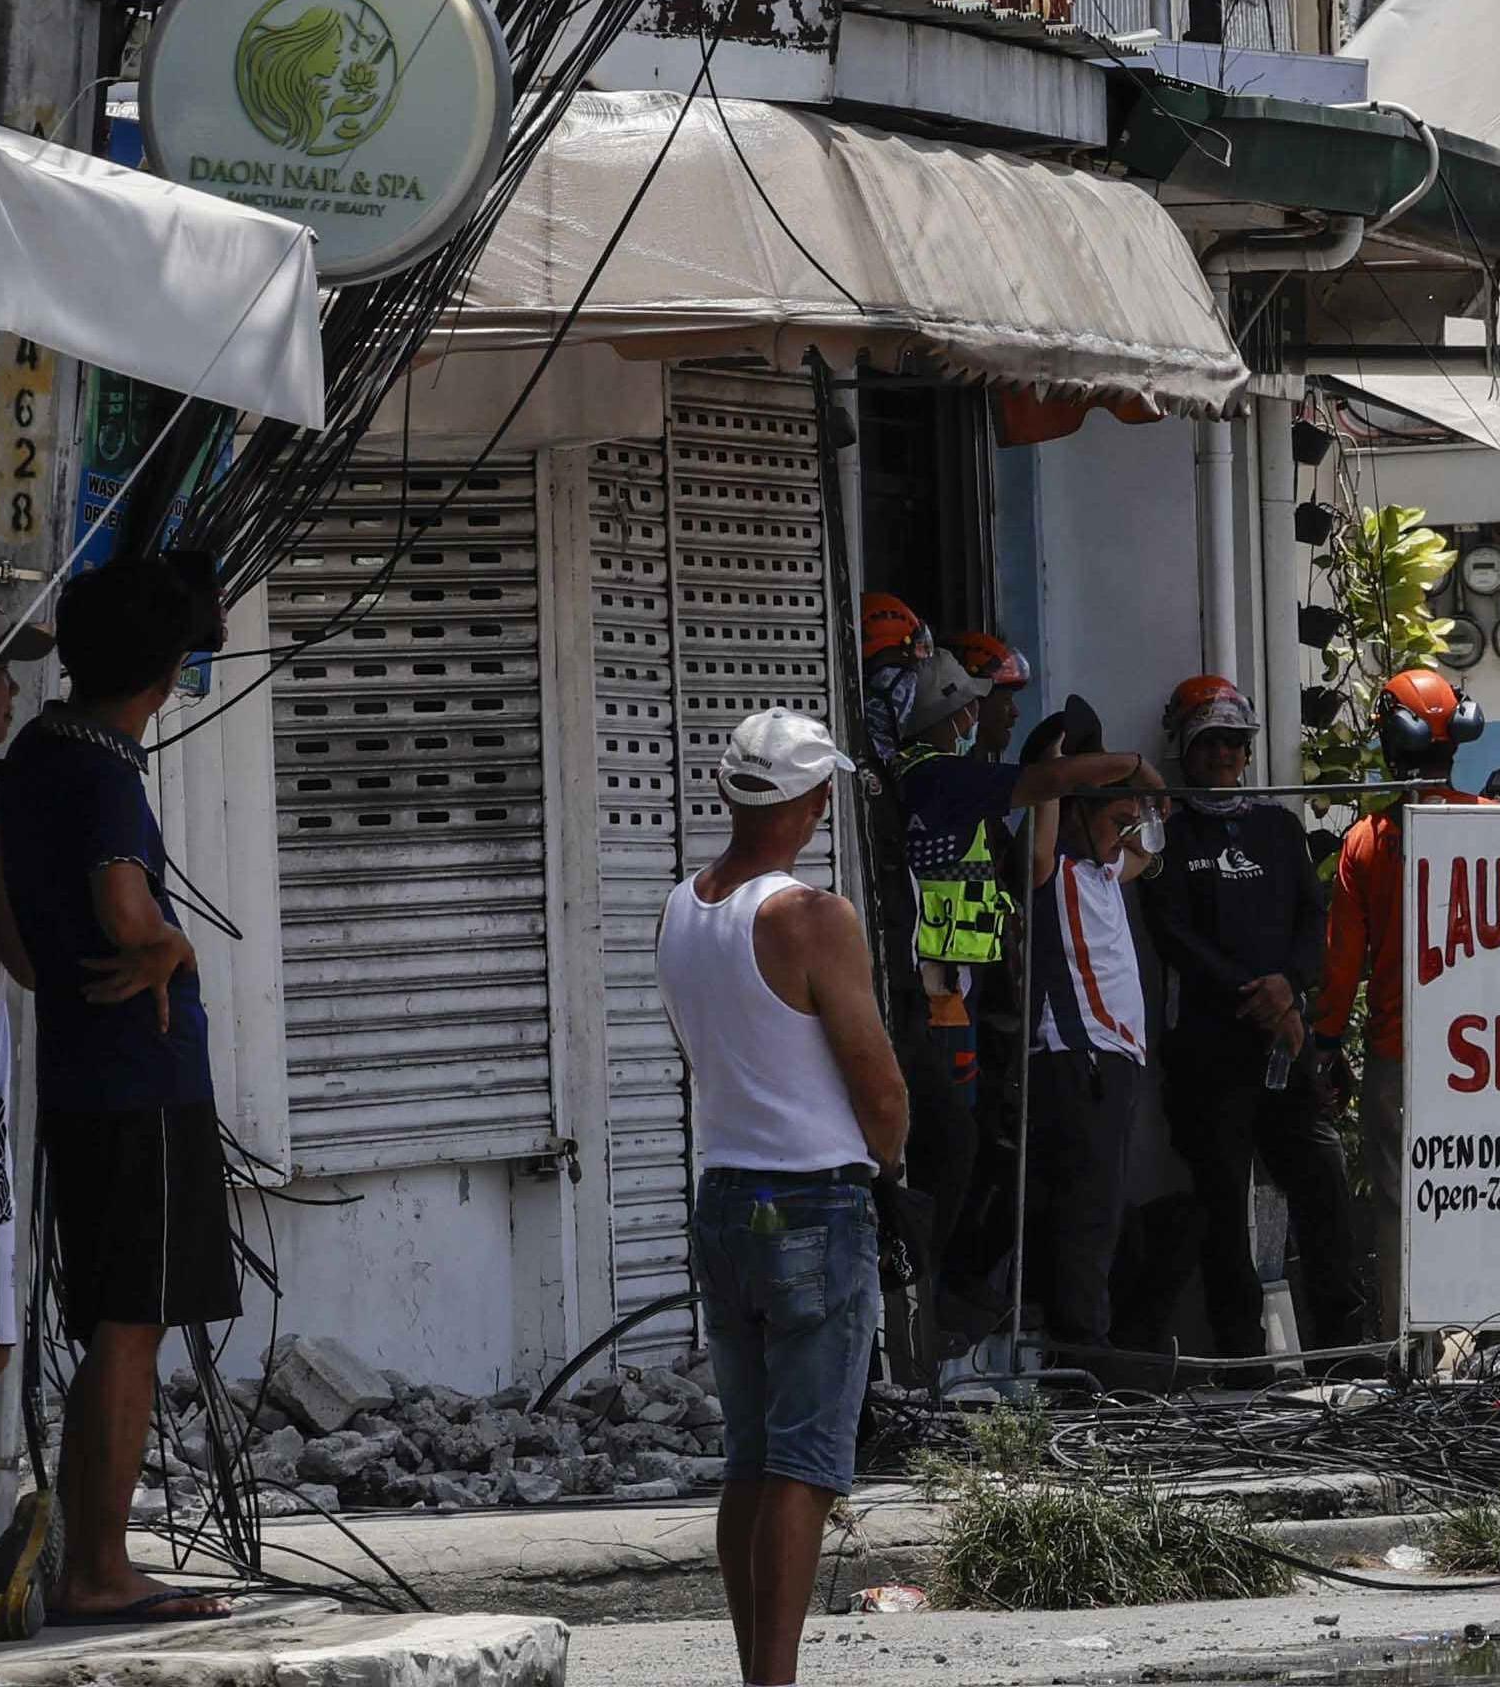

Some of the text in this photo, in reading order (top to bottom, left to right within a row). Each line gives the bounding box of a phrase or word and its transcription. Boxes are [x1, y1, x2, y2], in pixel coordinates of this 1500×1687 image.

[190, 155, 427, 202] DAON NAIL & SPA
[334, 201, 387, 218] BEAUTY
[1412, 1135, 1474, 1169] OPEN
